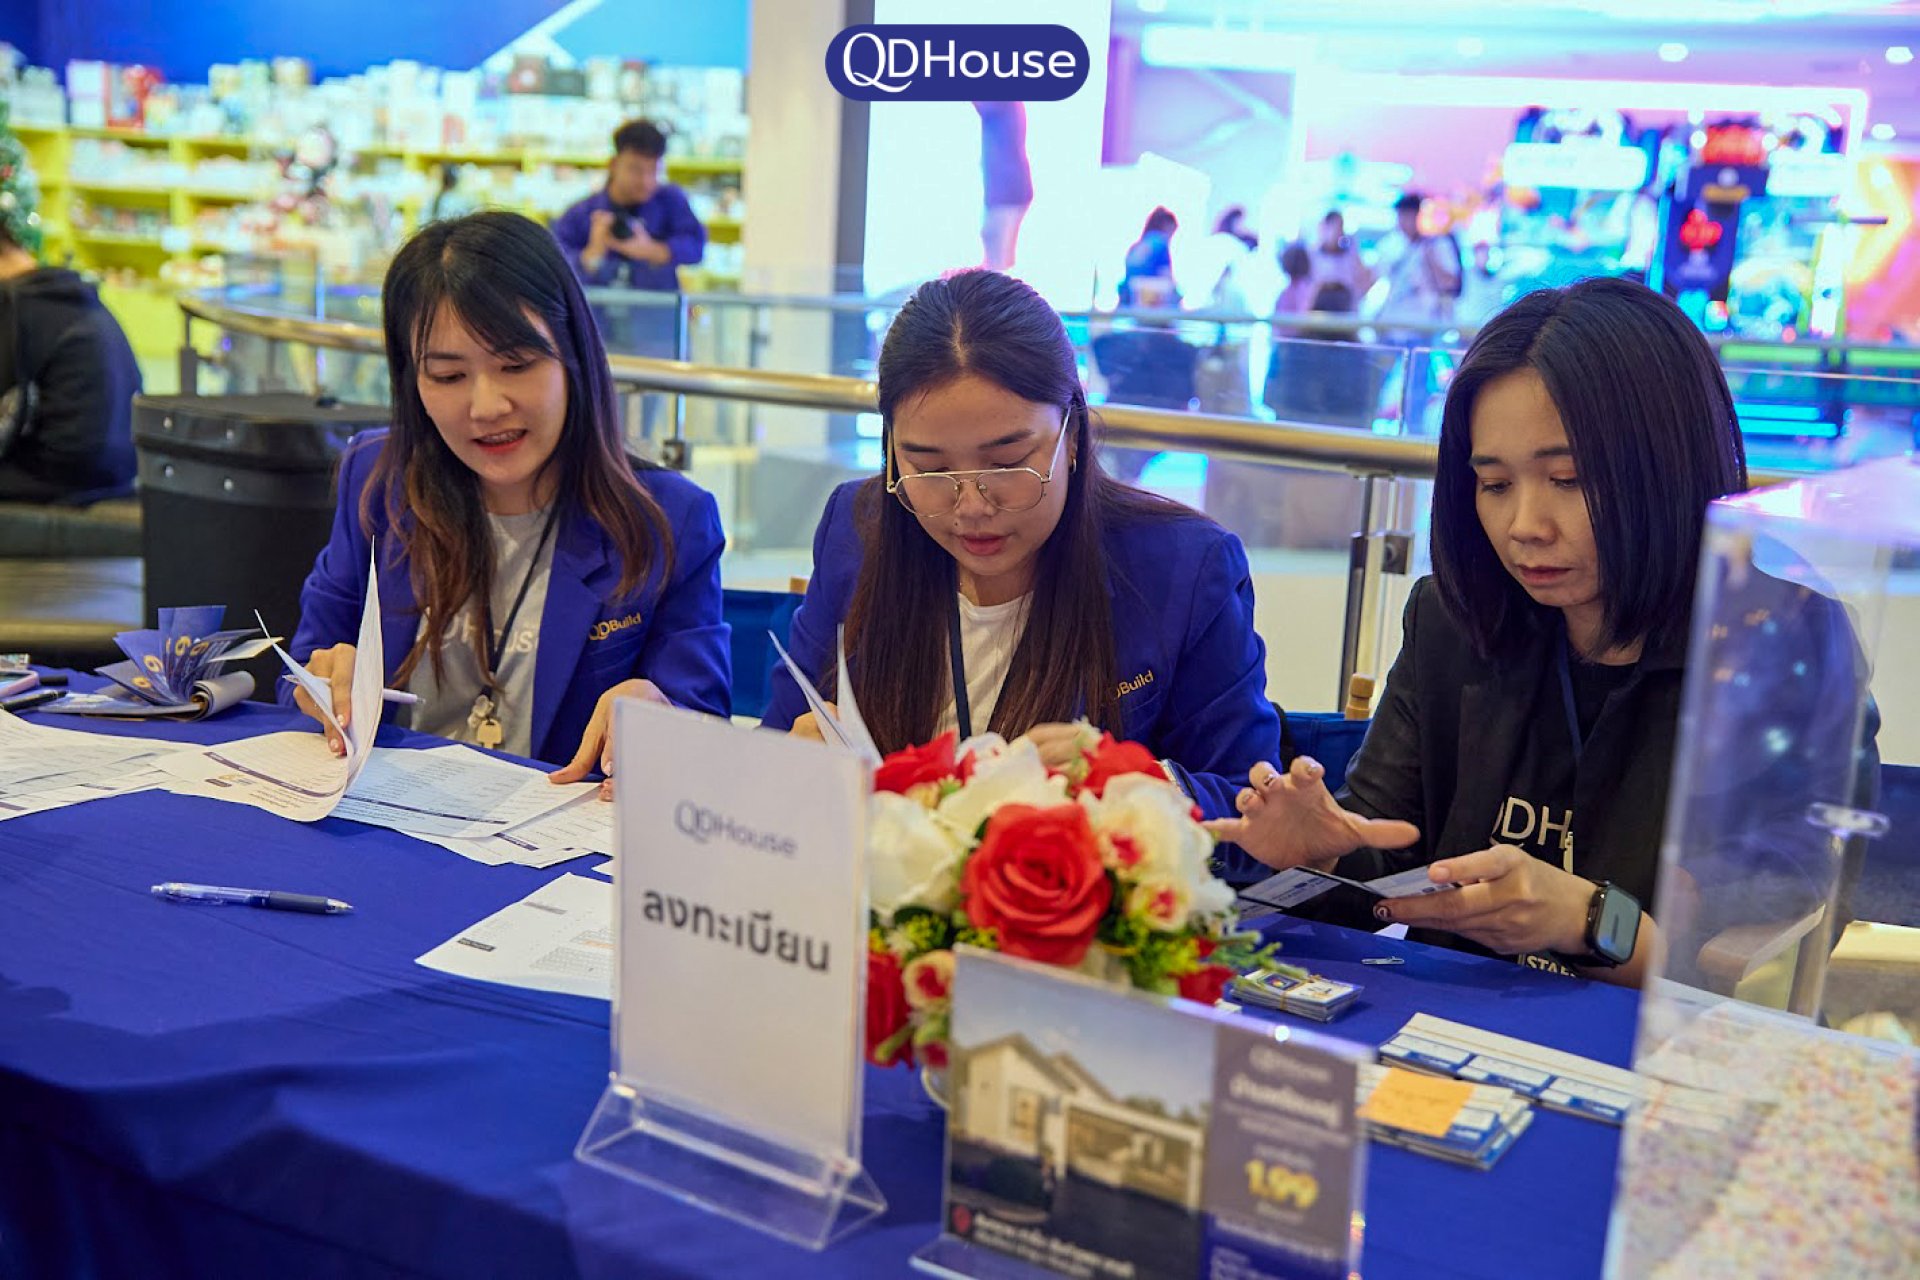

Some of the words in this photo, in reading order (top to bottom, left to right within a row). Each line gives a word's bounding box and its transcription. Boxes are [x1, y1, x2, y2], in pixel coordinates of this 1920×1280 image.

[1115, 669, 1155, 699] Build
[673, 799, 799, 857] QDHouse
[643, 888, 831, 972] ลงทะเบียน
[1526, 955, 1576, 978] STA
